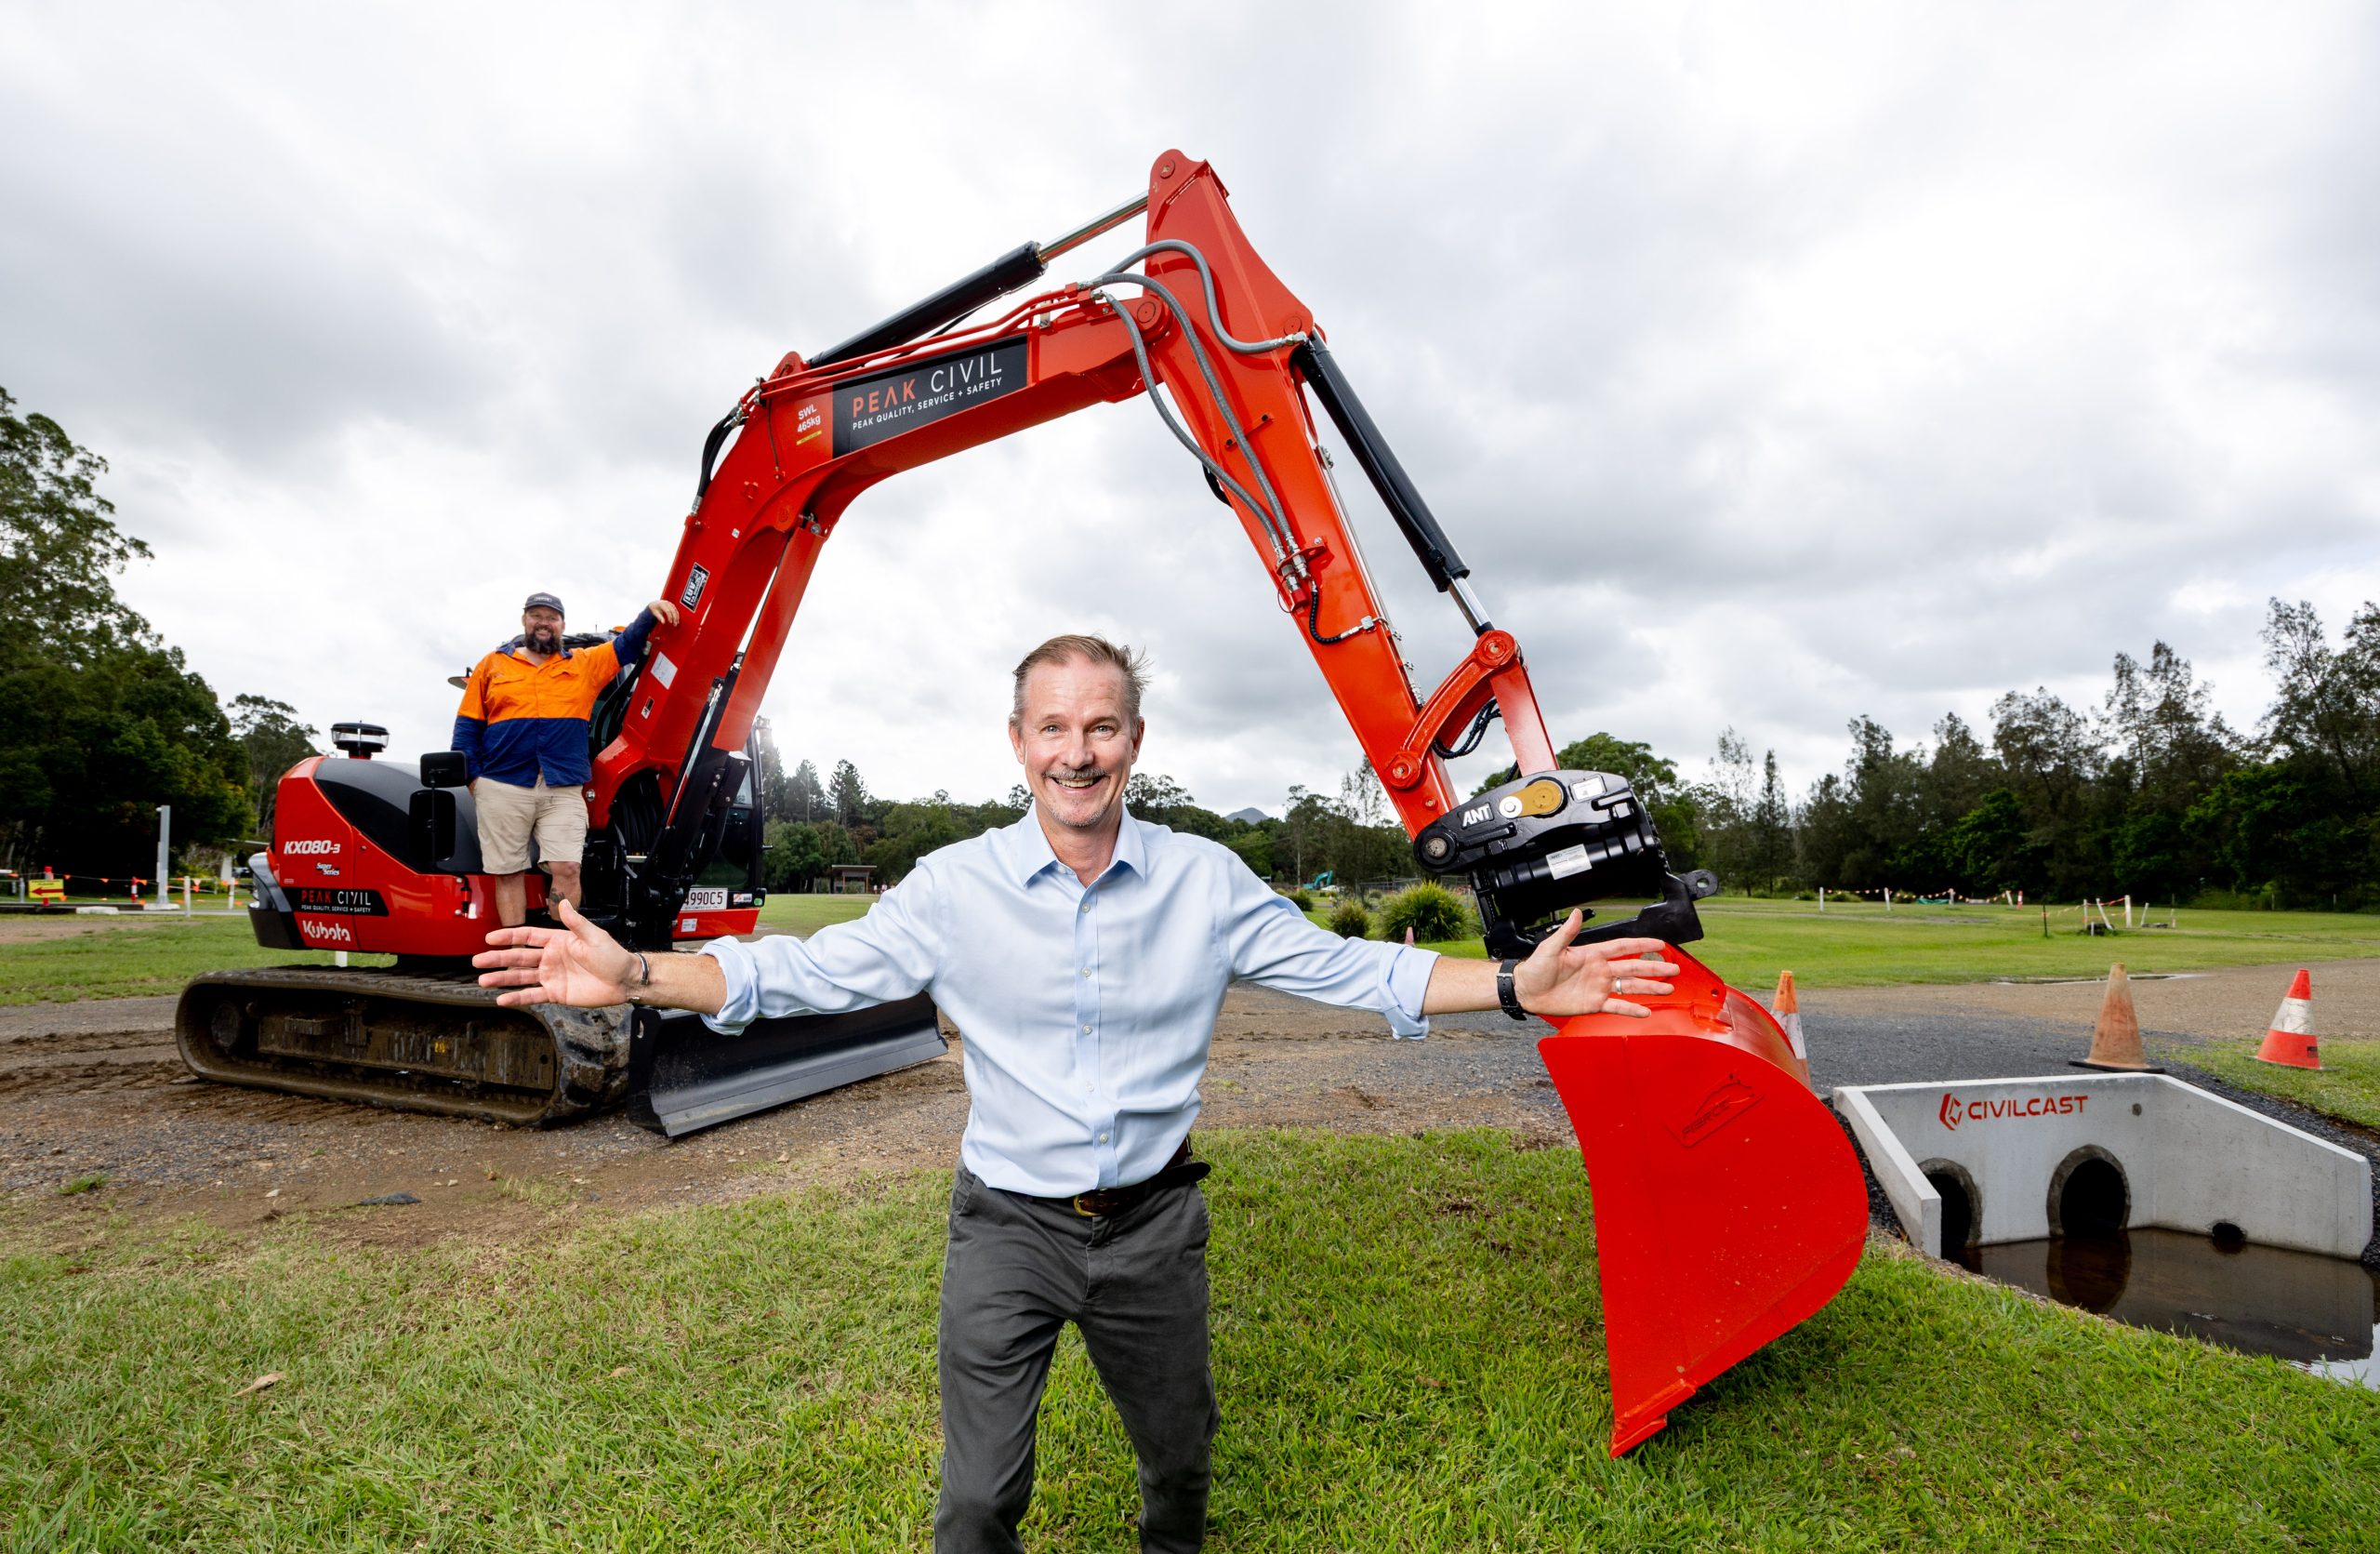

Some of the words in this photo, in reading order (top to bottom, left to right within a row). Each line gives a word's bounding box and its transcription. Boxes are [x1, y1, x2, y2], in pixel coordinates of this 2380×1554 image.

[853, 379, 916, 418] PEAK
[931, 352, 1002, 392] CIVIL
[799, 405, 817, 419] SWL
[853, 415, 874, 430] PEAK
[876, 405, 915, 423] QUALITY,
[918, 392, 954, 410] SERVICE
[967, 377, 1002, 394] SAFETY
[798, 415, 821, 432] 465kg
[1461, 804, 1490, 828] ANT
[284, 840, 340, 855] KX080-3
[301, 890, 331, 903] PEAK
[337, 891, 371, 906] CIVIL
[302, 920, 350, 942] Kubota
[1968, 1096, 2088, 1120] CIVILCAST
